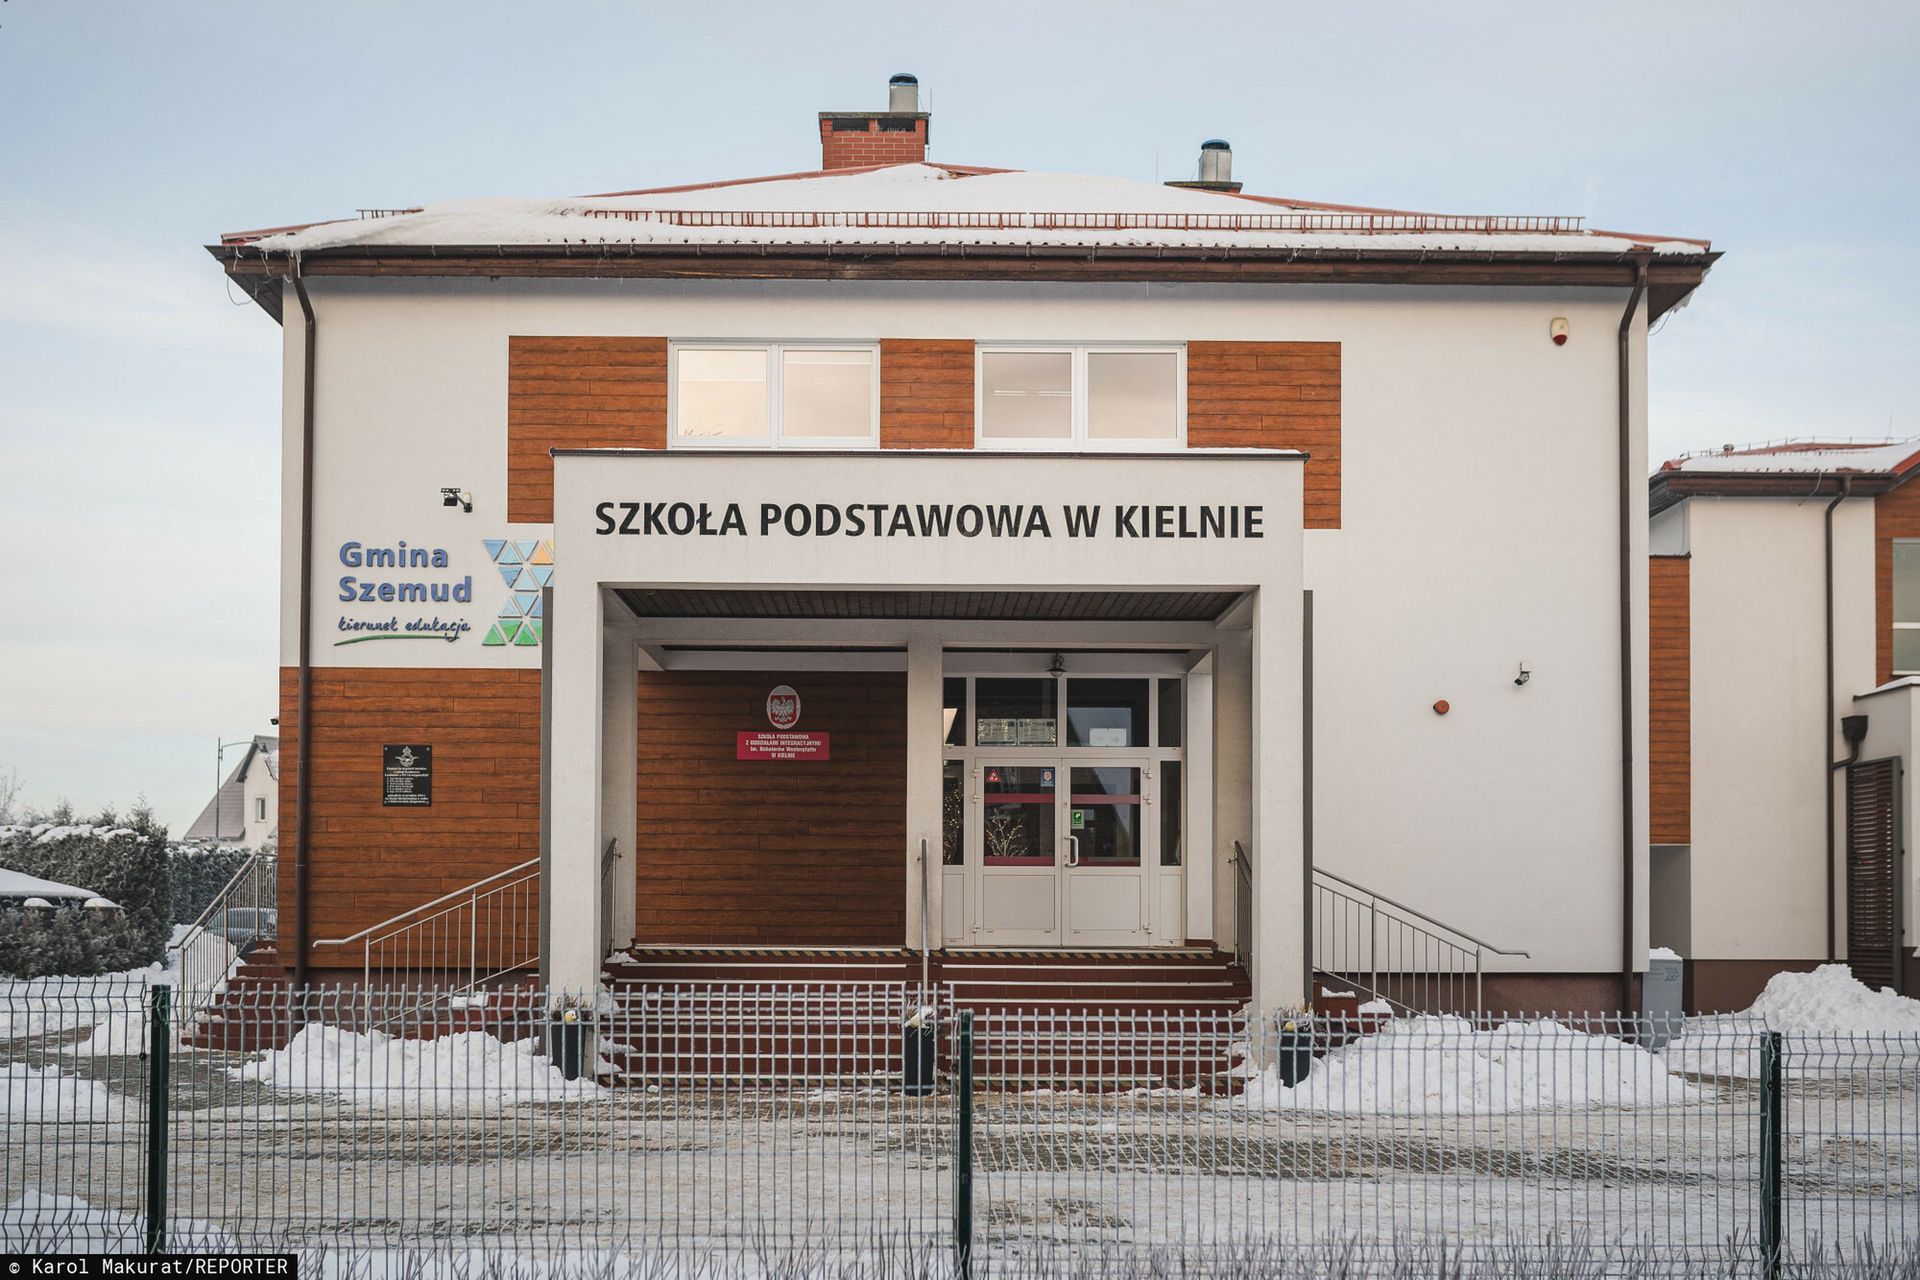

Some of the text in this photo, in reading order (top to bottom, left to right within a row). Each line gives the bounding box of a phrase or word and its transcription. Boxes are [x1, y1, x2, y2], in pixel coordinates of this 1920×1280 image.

[595, 502, 1264, 539] SZKOŁA PODSTAWOWA W KIELNIE
[339, 540, 449, 568] Gmina
[339, 575, 472, 603] Szemud
[338, 616, 398, 631] kierunek
